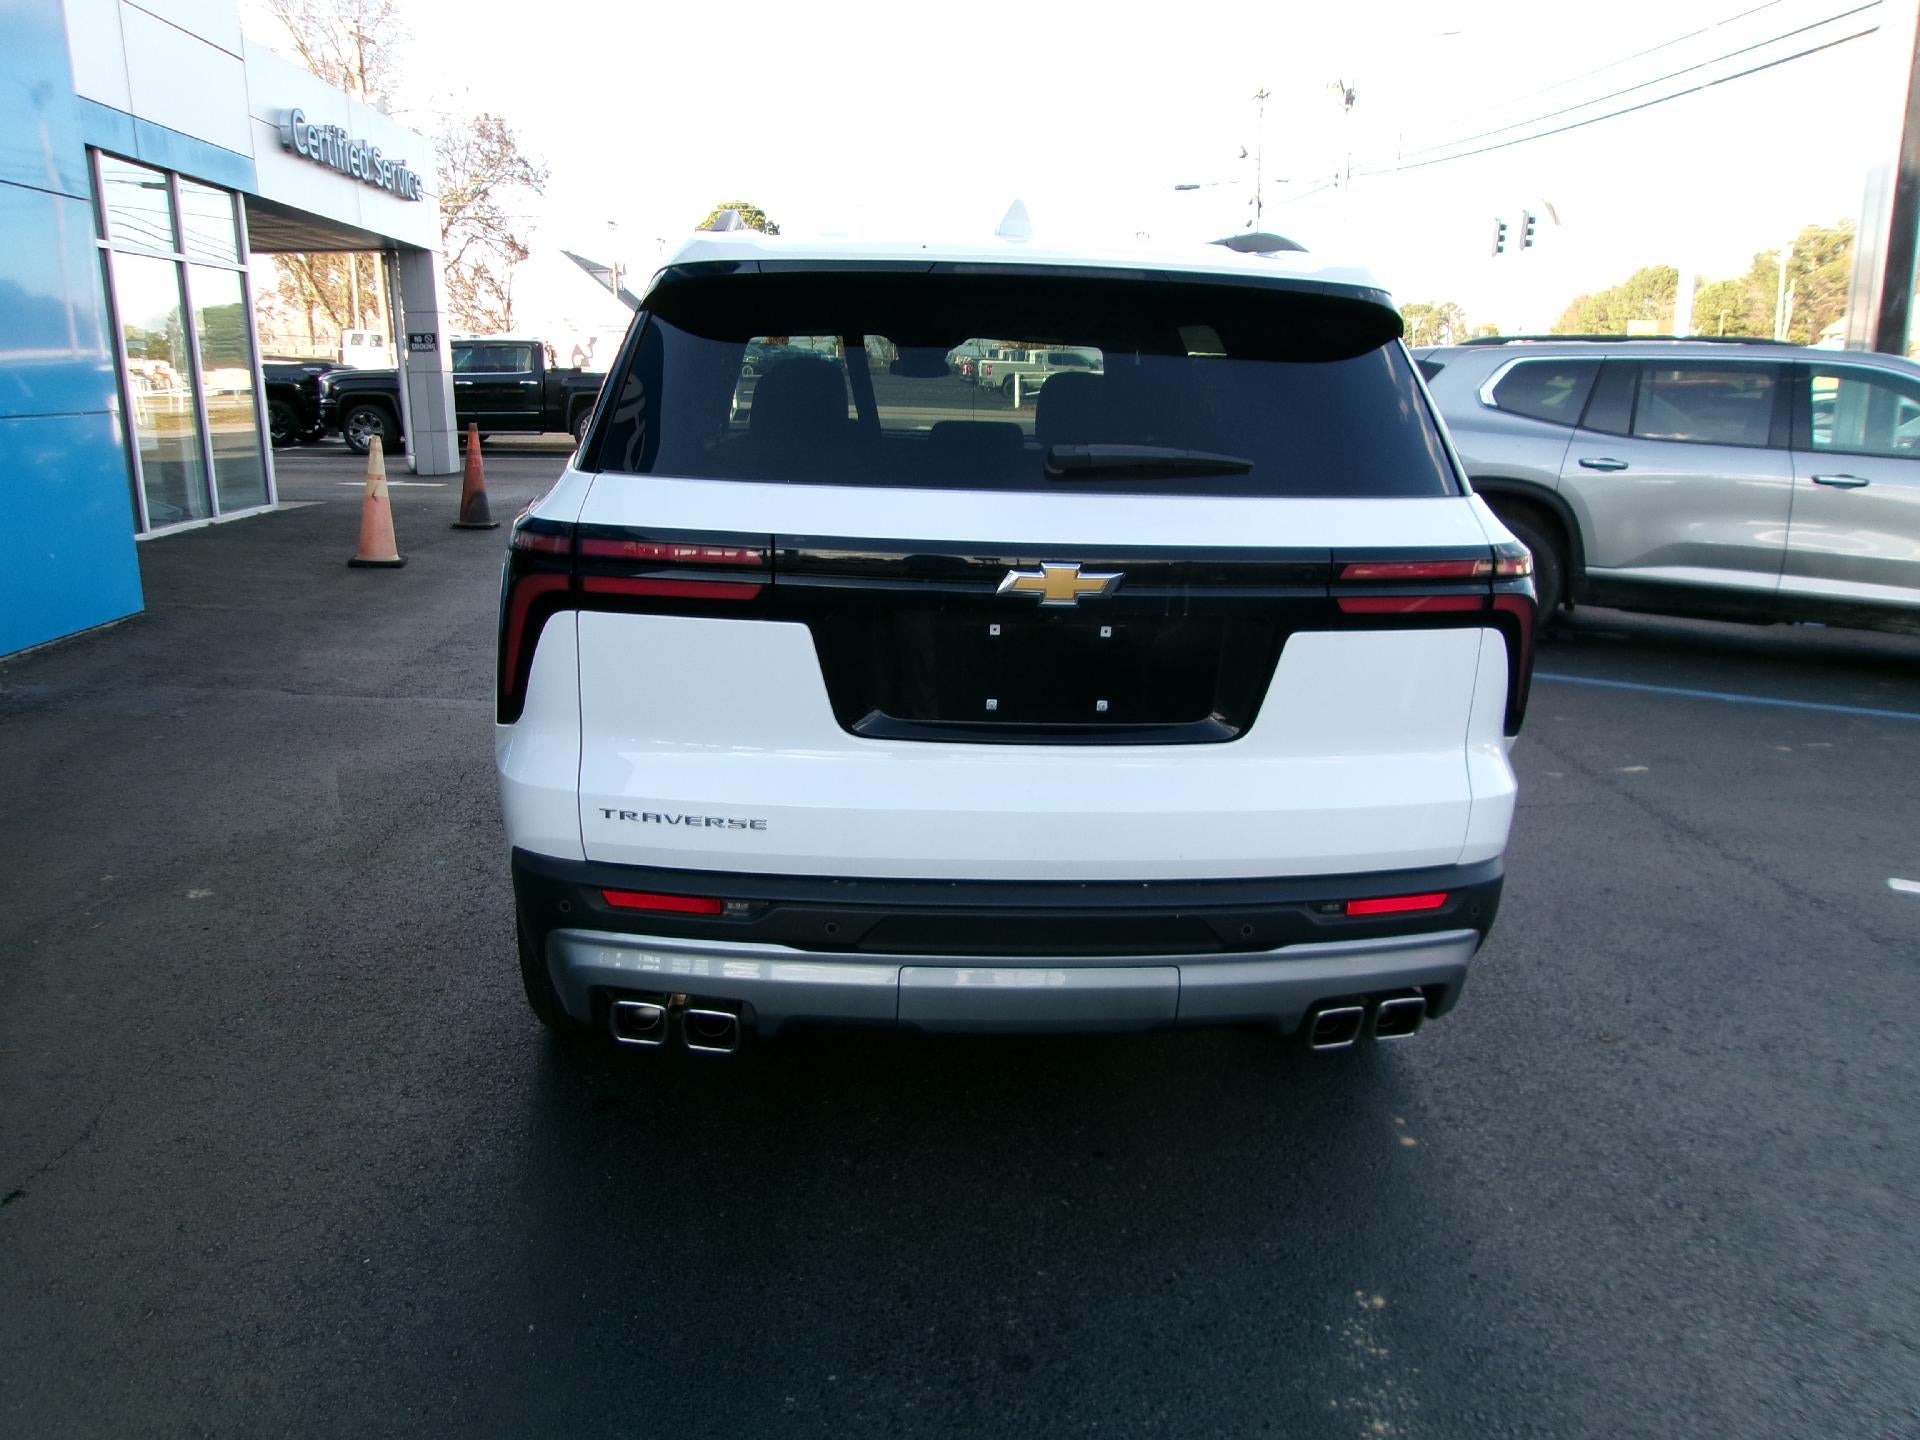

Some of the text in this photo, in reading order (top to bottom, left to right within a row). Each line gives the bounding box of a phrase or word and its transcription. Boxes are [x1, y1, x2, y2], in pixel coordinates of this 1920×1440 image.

[288, 108, 424, 201] Certified Service
[413, 335, 423, 343] NO
[599, 807, 768, 831] TRAVERSE
